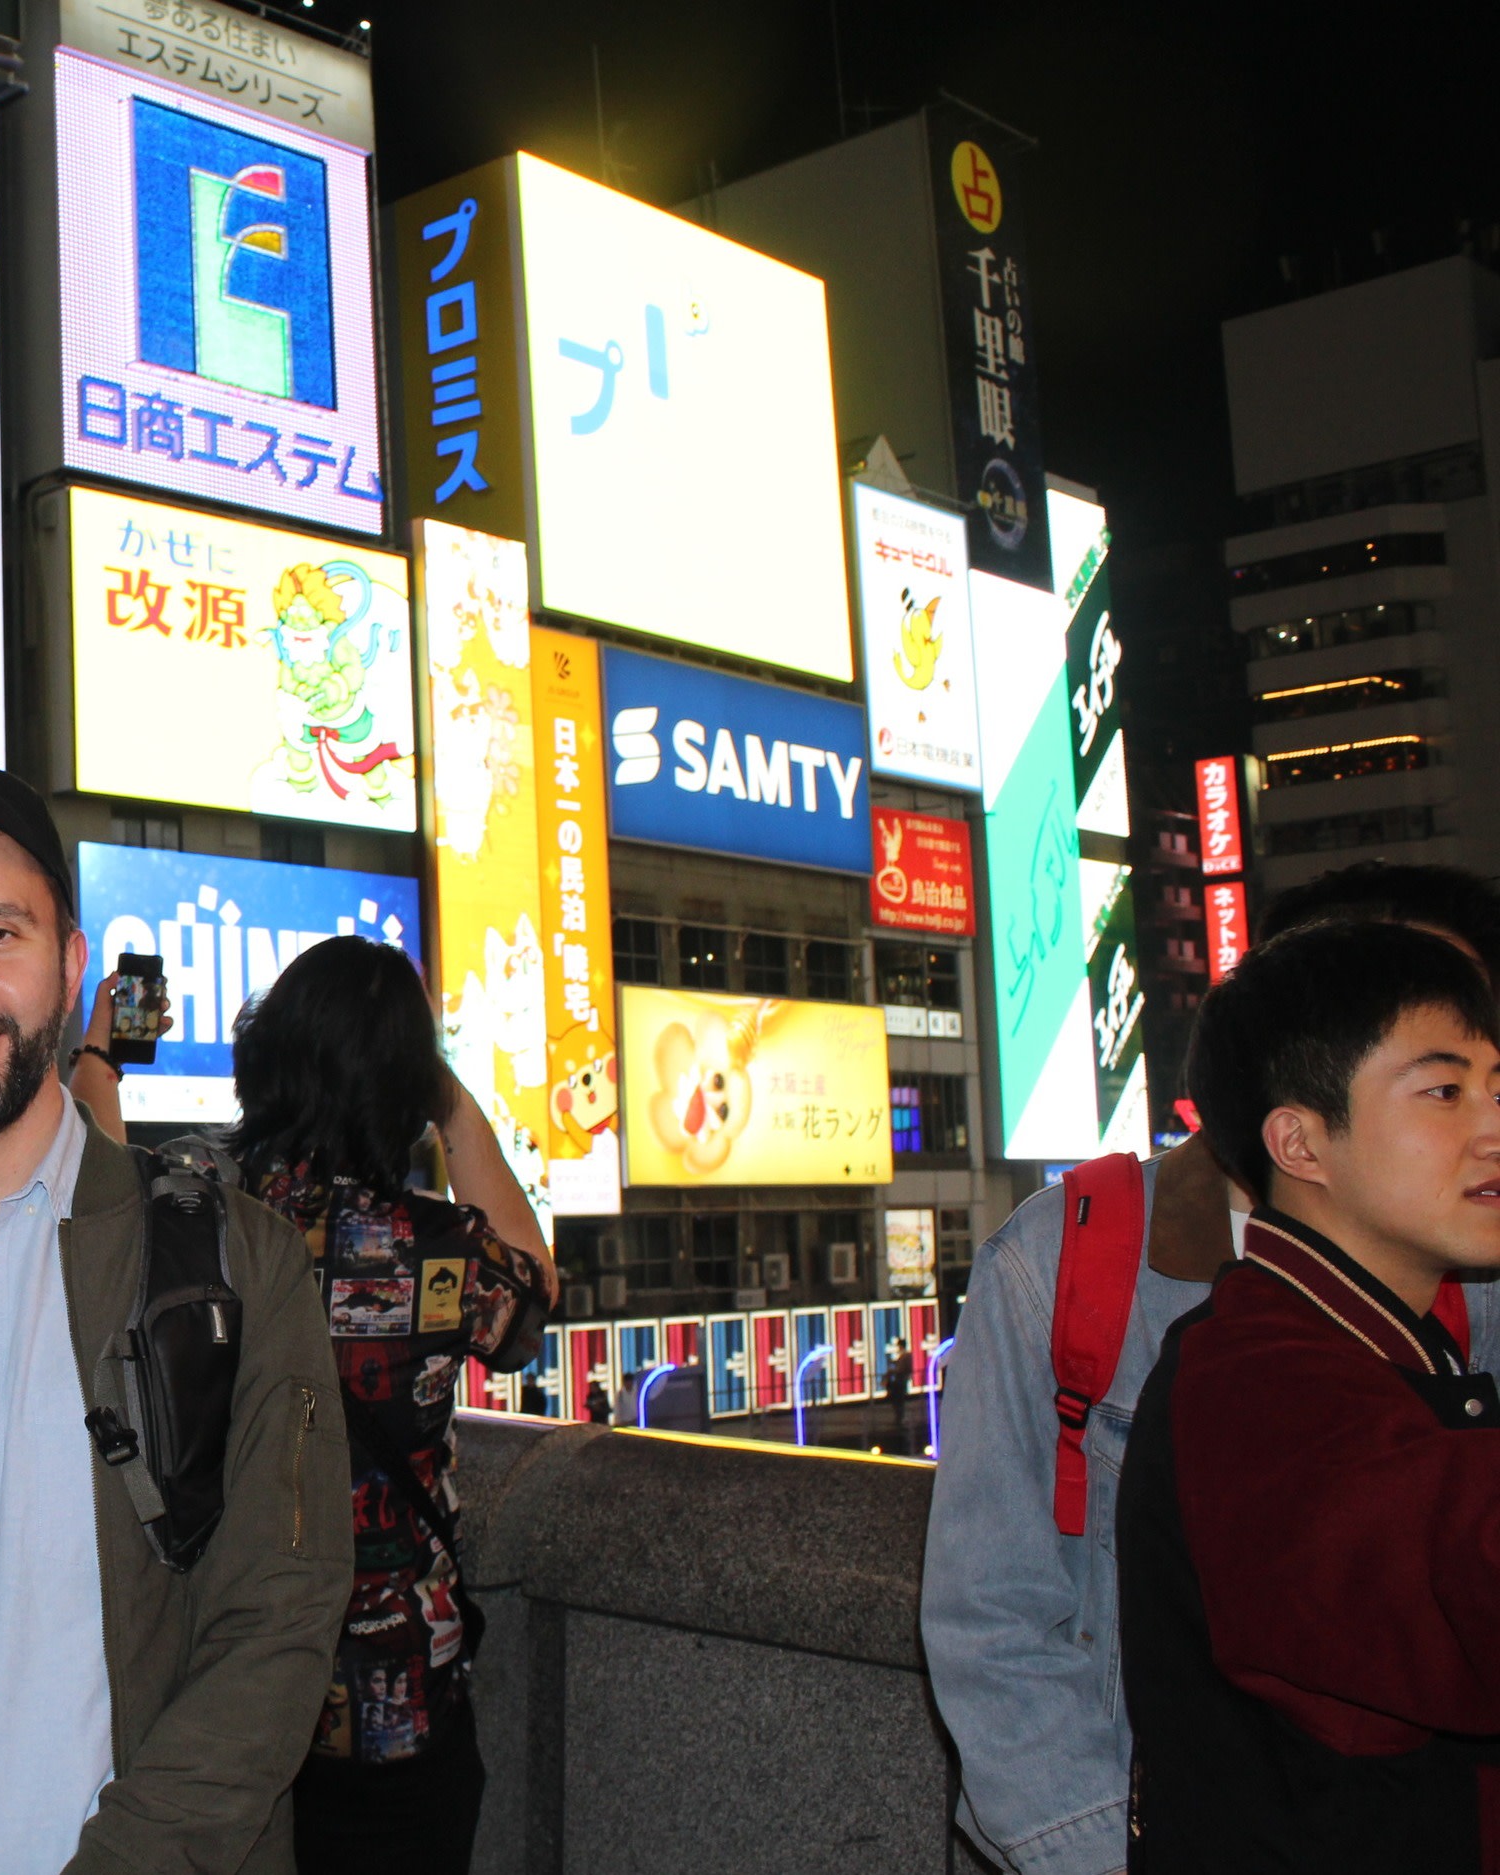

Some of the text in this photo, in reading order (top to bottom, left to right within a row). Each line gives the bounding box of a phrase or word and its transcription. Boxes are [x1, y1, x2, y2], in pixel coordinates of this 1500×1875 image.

[117, 28, 324, 124] エステムシリーズ
[961, 147, 994, 226] 占
[422, 198, 489, 504] プロミス
[966, 247, 1016, 450] 千里眼
[78, 375, 385, 502] 日商エステム
[104, 566, 248, 649] 改源
[672, 718, 863, 820] SAMTY
[1203, 761, 1232, 856] カラオケ
